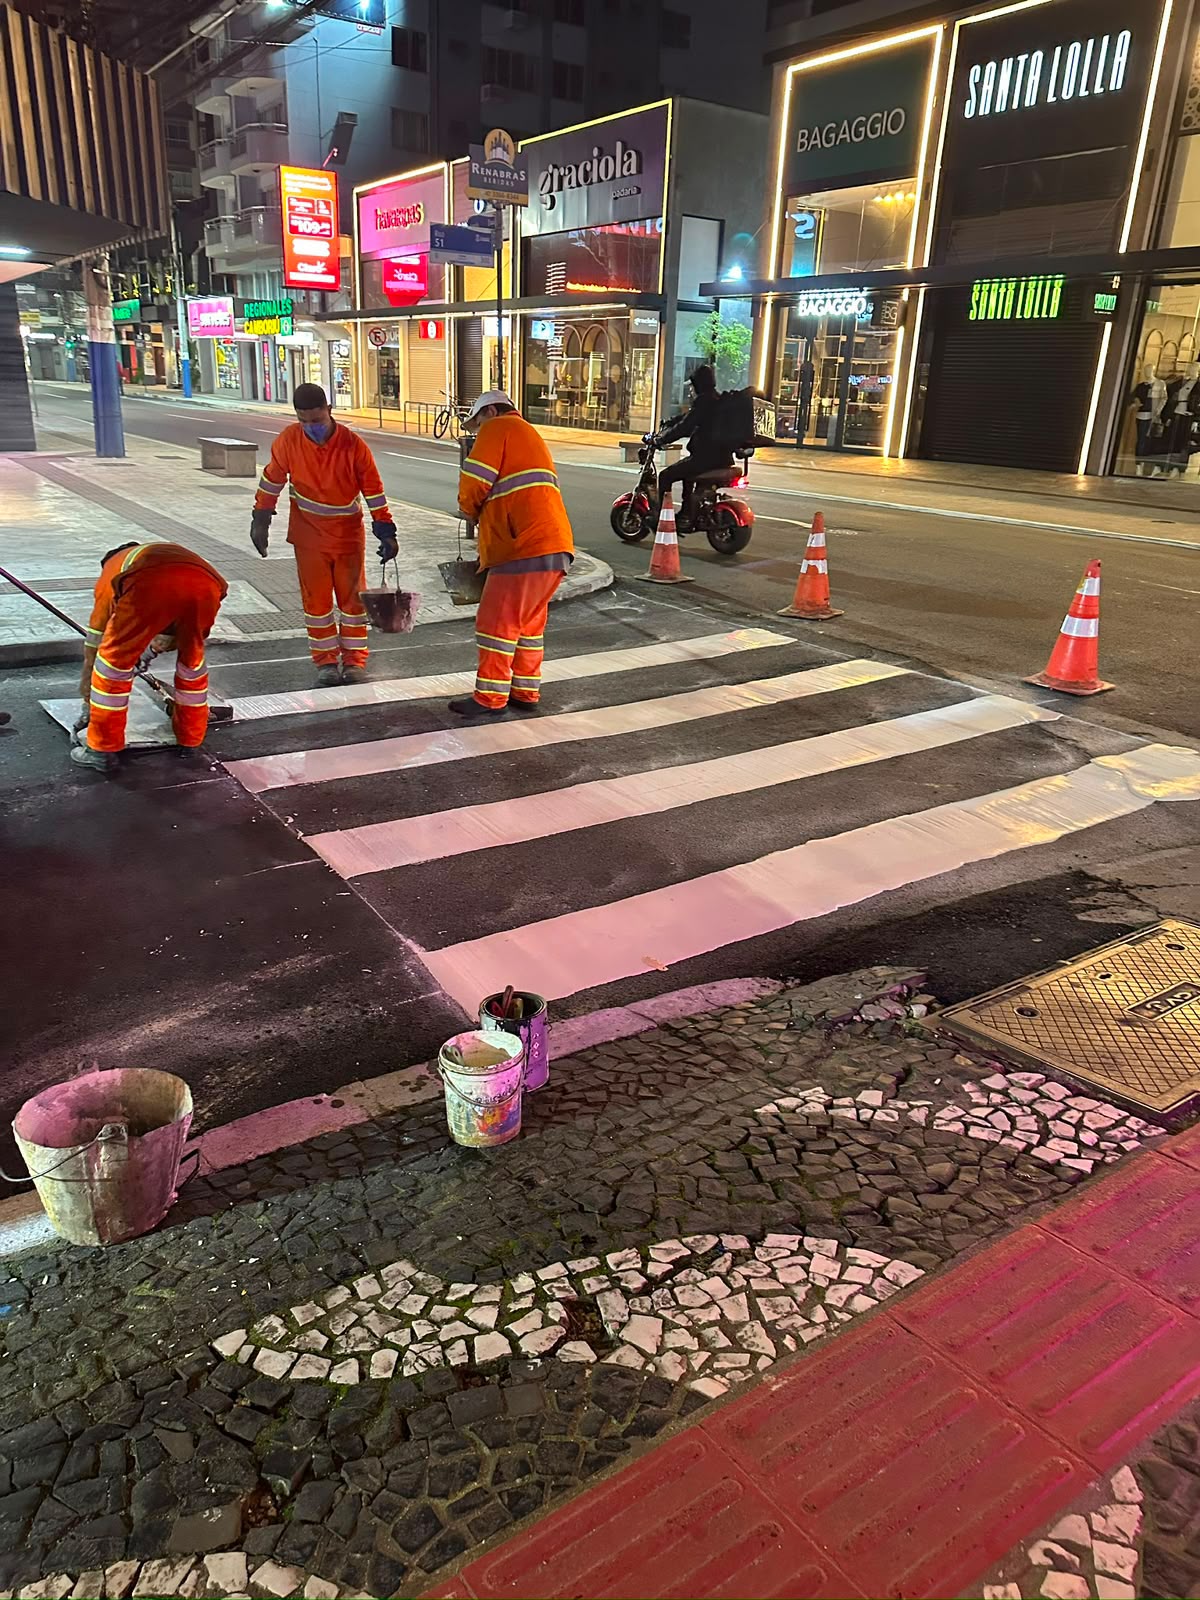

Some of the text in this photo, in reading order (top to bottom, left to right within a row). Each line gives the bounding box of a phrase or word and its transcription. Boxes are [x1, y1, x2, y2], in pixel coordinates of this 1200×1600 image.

[963, 29, 1132, 119] SANTA LOLLA
[796, 107, 906, 153] BAGAGGIO
[538, 140, 640, 210] graciola
[611, 185, 640, 200] padaria
[434, 238, 445, 248] 51
[243, 298, 293, 318] REGIONALES
[799, 297, 867, 317] BAGAGGIO
[969, 281, 1016, 321] SANTA
[1016, 277, 1064, 319] LOLLA
